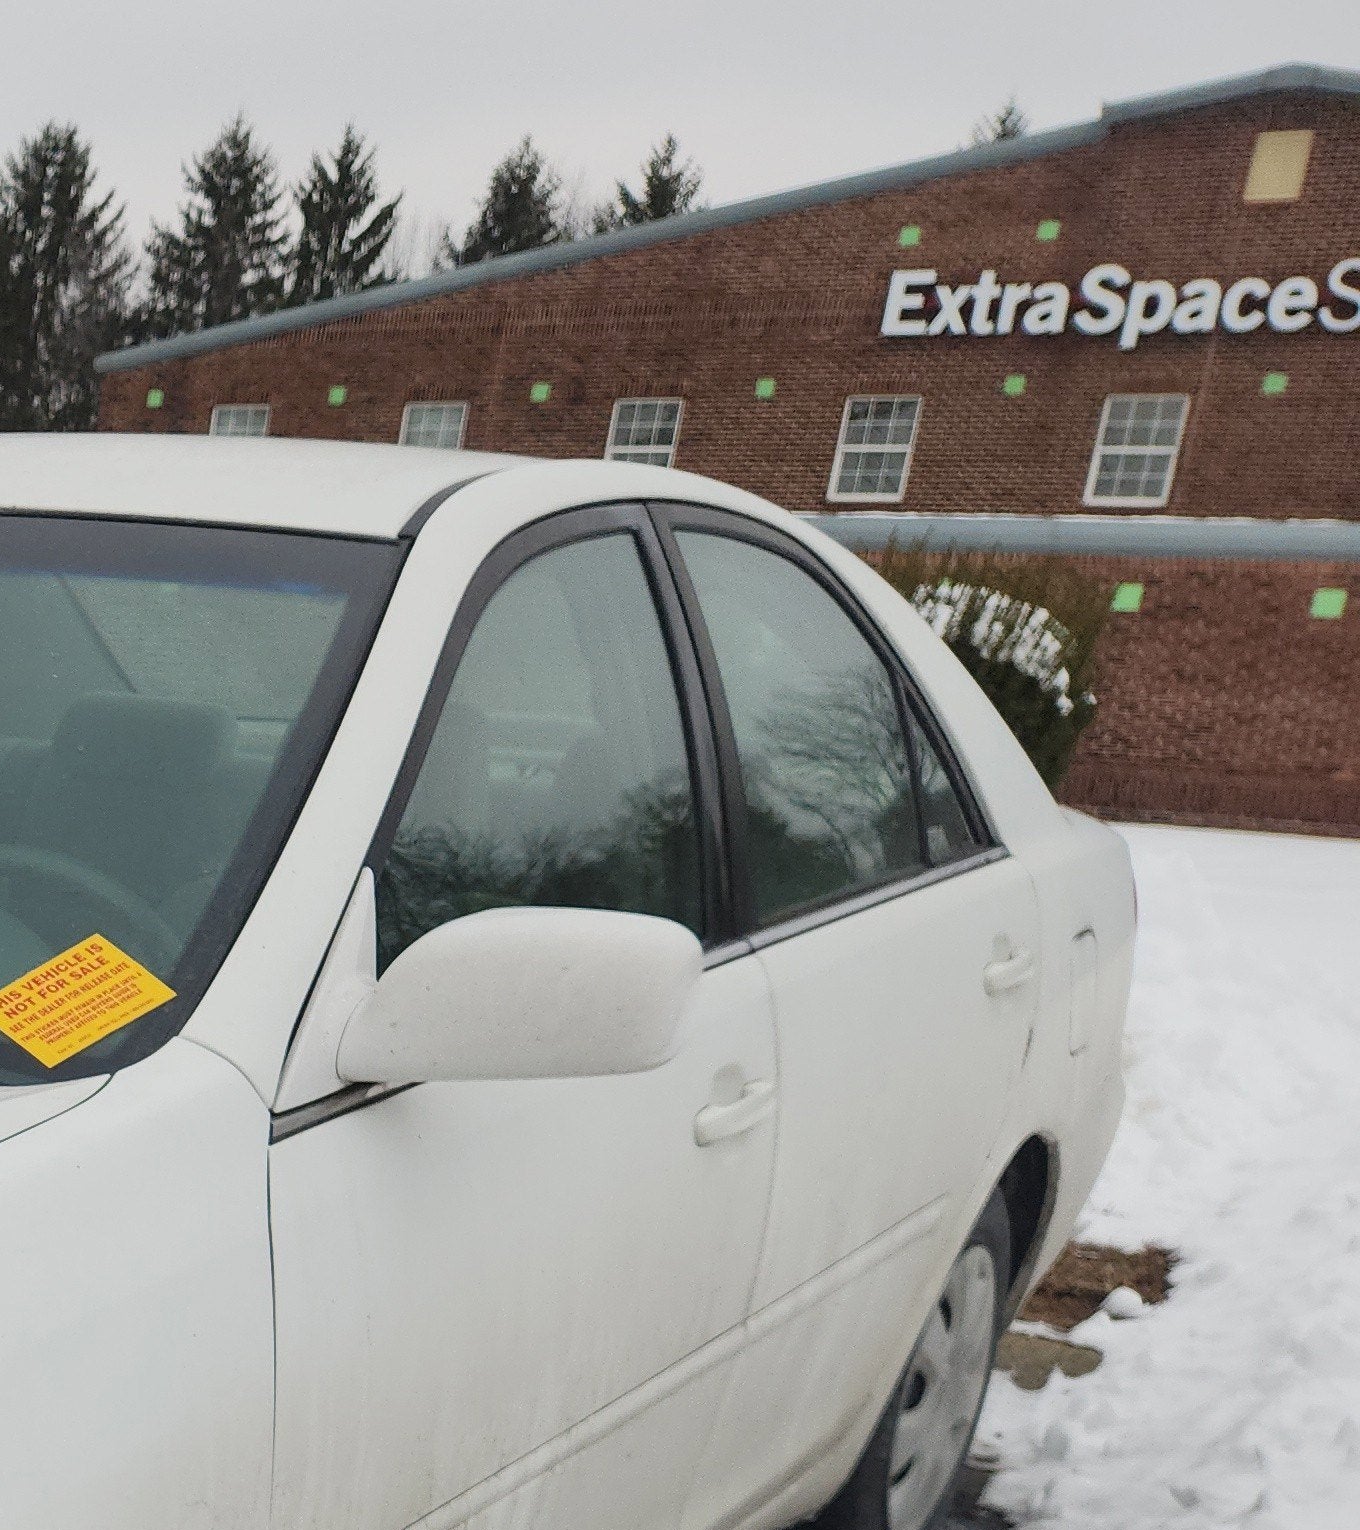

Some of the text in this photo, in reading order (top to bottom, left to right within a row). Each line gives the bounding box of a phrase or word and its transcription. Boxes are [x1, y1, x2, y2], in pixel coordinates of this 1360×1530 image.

[2, 954, 110, 1019] NOT FOR SALE
[8, 960, 131, 1033] SEE THE DEALER FOR RELEASE DATE
[19, 951, 86, 993] VEHICLE
[83, 941, 104, 956] IS
